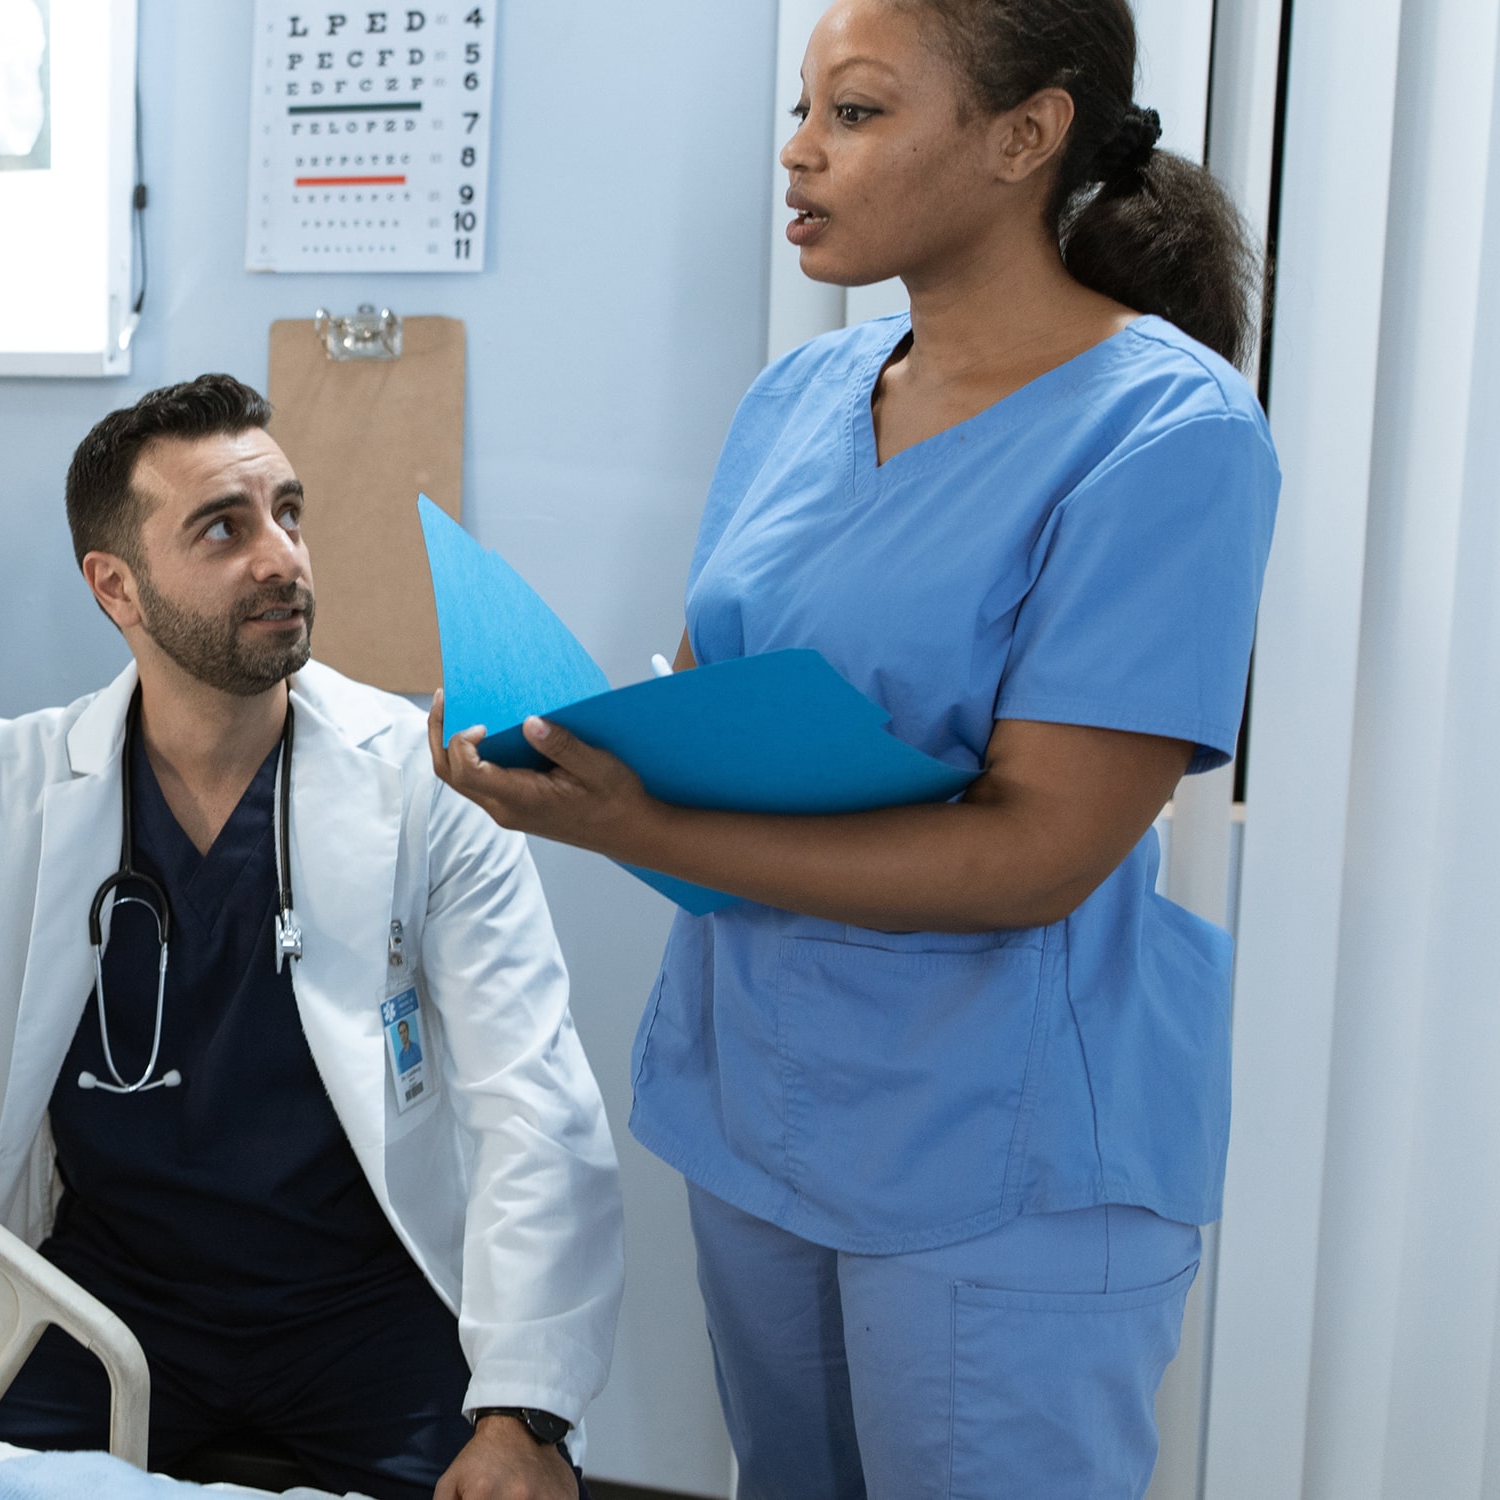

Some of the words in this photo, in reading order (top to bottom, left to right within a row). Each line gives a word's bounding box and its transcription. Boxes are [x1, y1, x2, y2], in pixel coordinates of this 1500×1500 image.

[464, 7, 484, 29] 4
[464, 43, 481, 65] 5
[463, 72, 479, 91] 6
[462, 111, 480, 134] 7
[460, 146, 476, 168] 8
[458, 184, 475, 205] 9
[453, 211, 477, 233] 10
[454, 238, 472, 260] 11
